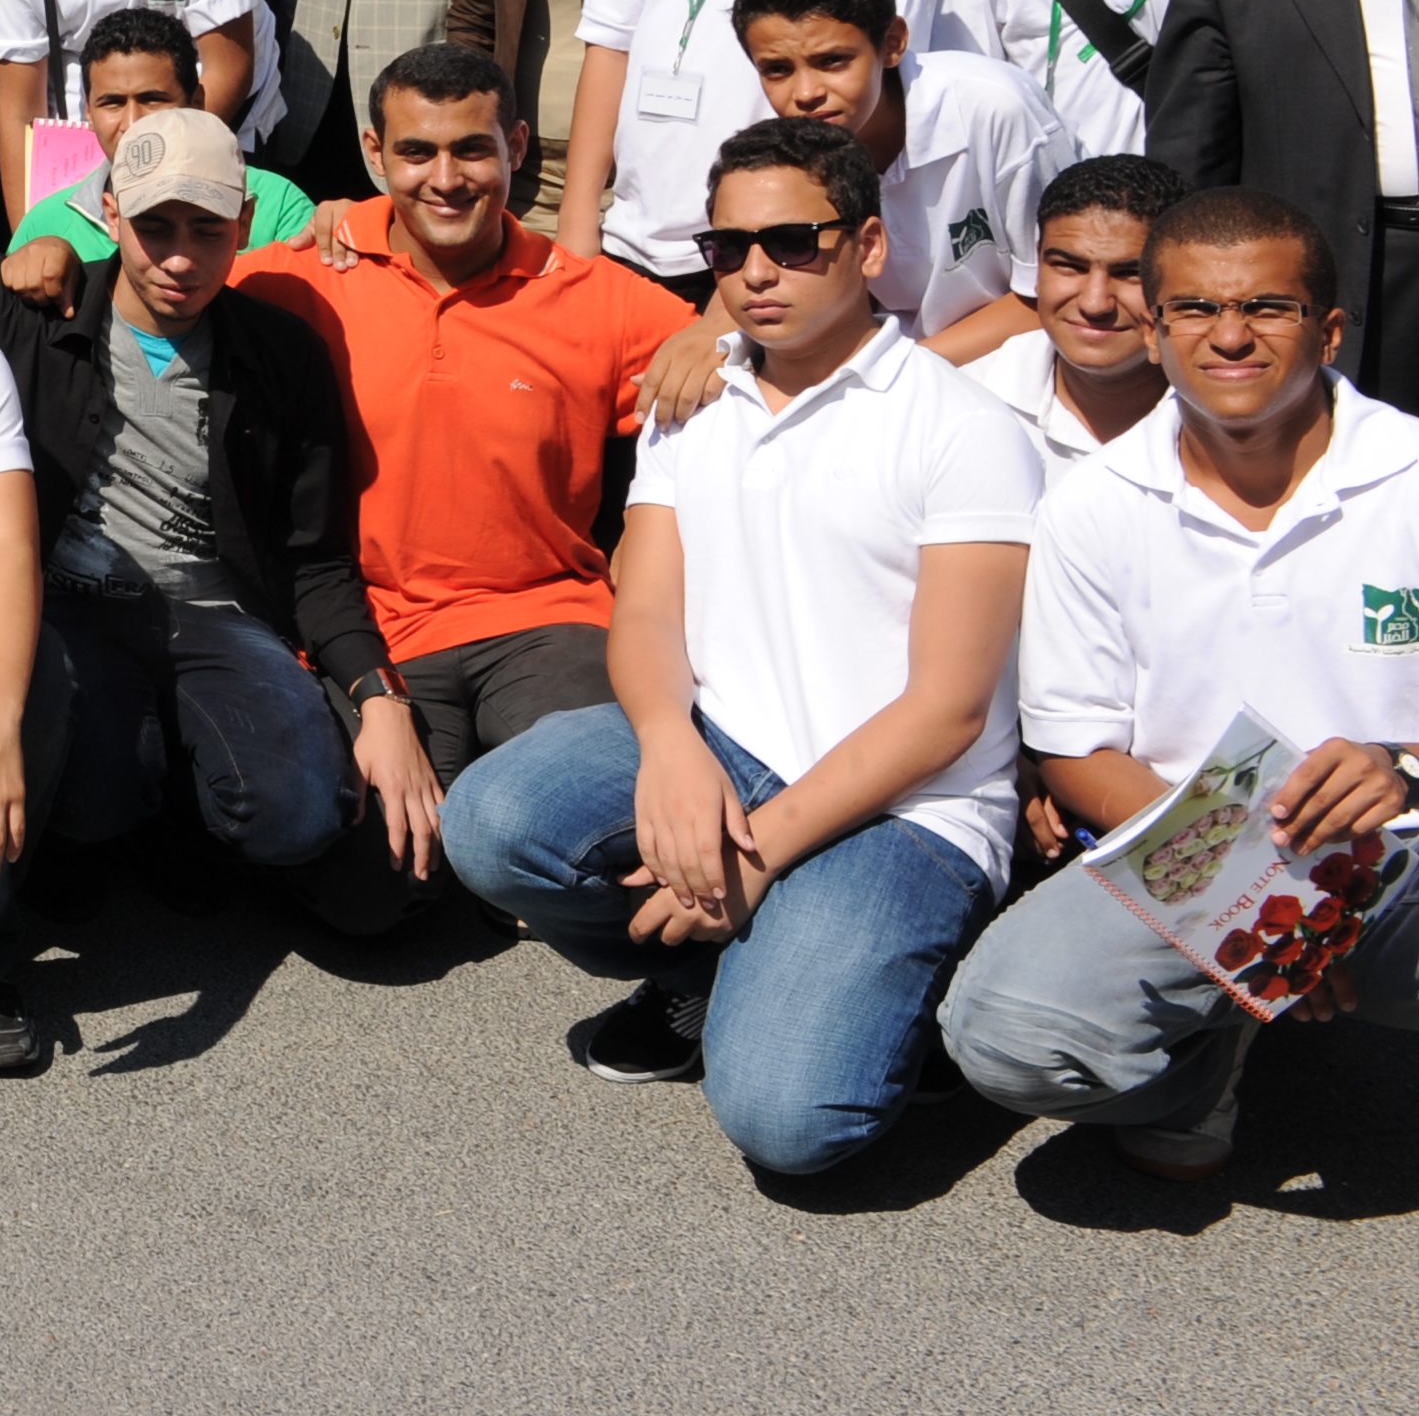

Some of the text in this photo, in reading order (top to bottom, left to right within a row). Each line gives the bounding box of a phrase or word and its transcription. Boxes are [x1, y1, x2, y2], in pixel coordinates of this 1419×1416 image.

[131, 139, 153, 170] 90
[1208, 852, 1292, 931] NOTE BOOK
